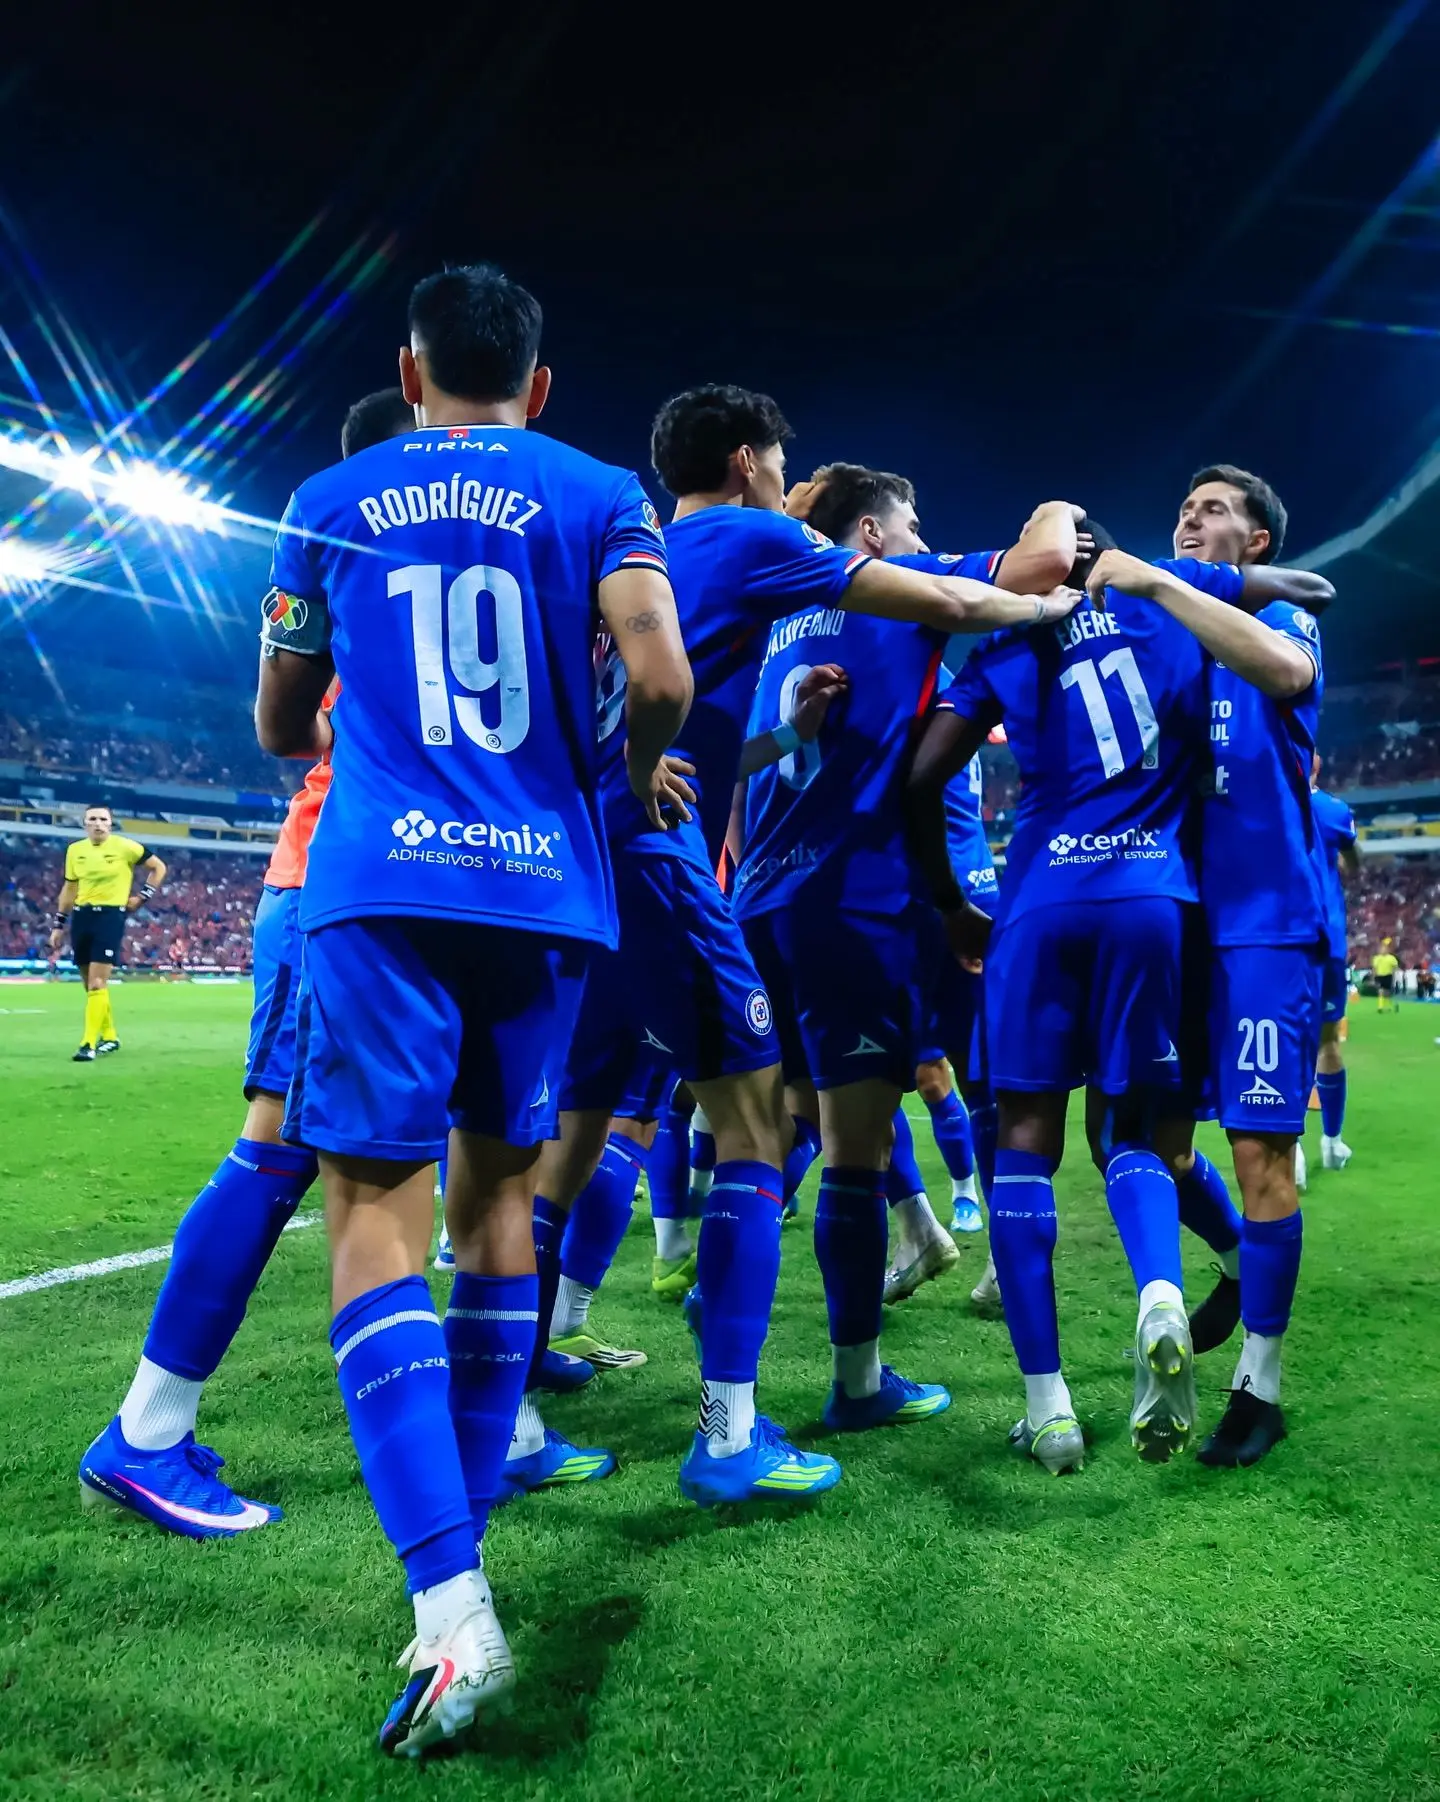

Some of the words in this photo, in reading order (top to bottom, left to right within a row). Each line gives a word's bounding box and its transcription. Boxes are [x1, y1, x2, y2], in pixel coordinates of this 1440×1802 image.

[403, 441, 509, 453] PIRMA
[358, 473, 543, 537] RODRÍGUEZ
[1056, 609, 1121, 651] EBERE
[387, 564, 530, 754] 19
[1059, 647, 1160, 779] 11
[1210, 700, 1232, 718] TO
[387, 848, 484, 868] ADHESIVOS
[490, 857, 501, 869] Y
[506, 860, 563, 881] ESTUCOS
[1049, 851, 1112, 867] ADHESIVOS
[1124, 851, 1168, 859] ESTUCOS
[1238, 1018, 1278, 1072] 20
[997, 1210, 1033, 1218] CRUZ
[356, 1366, 403, 1401] CRUZ
[409, 1356, 449, 1372] AZUL
